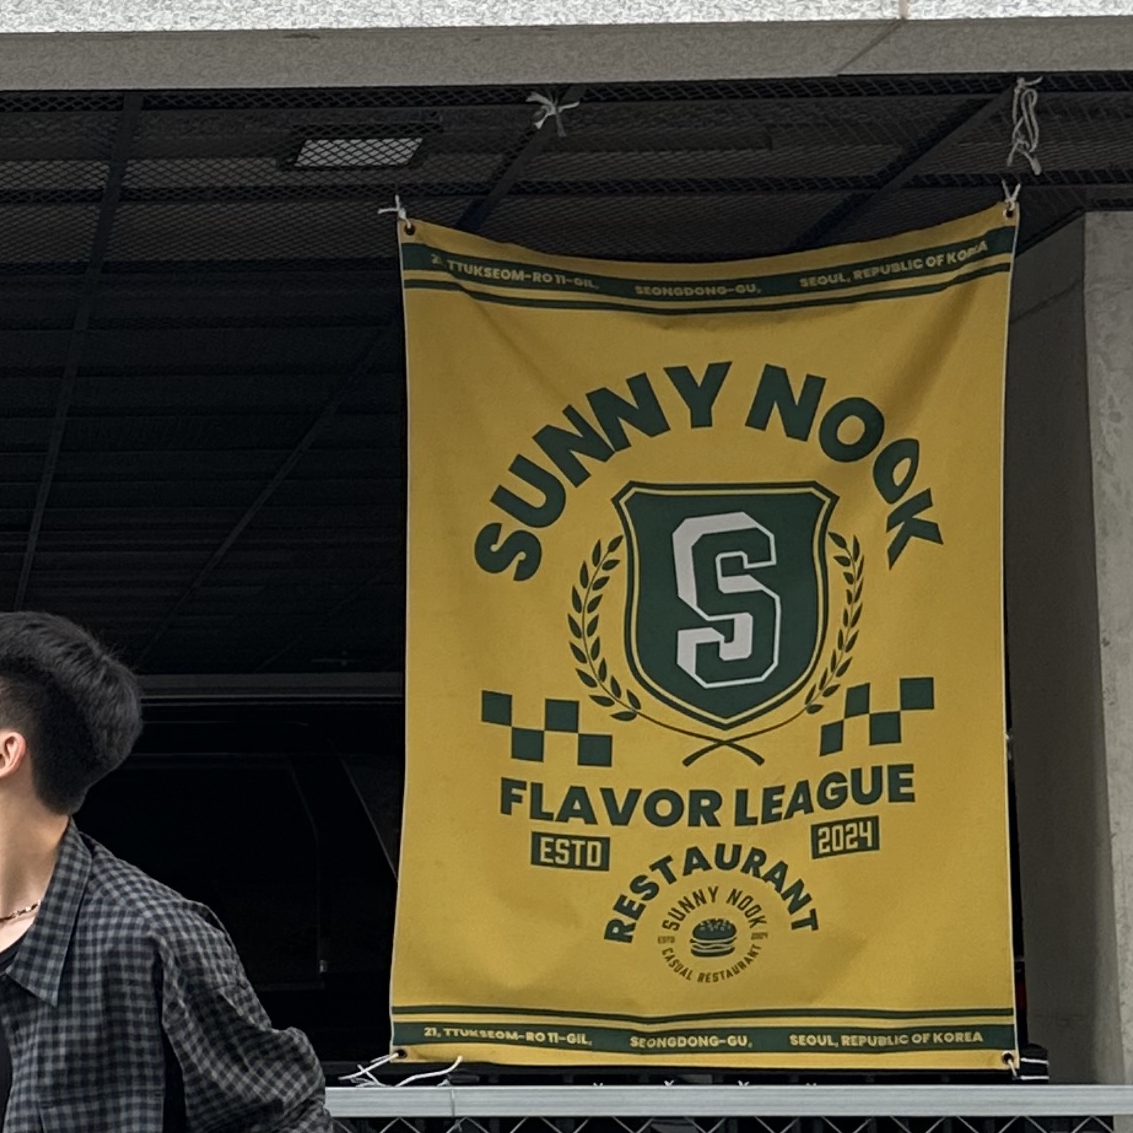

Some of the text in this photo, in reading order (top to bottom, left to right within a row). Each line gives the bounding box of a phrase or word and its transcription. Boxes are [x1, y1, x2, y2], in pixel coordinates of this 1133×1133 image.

[798, 273, 852, 289] SEOUL,
[853, 257, 924, 281] REPUBLIC
[925, 254, 945, 268] OF
[634, 282, 762, 297] SEONGDONG-GU,
[473, 361, 945, 582] SUNNY NOOK
[500, 763, 916, 828] FLAVOR LEAGUE
[539, 835, 603, 868] ESTD
[817, 820, 874, 855] 2024
[603, 842, 820, 944] RESTAURANT
[661, 885, 768, 931] SUNNY NOOK
[661, 943, 762, 983] CASUAL RESTAURANT
[423, 1027, 442, 1038] 21,
[444, 1027, 546, 1042] TTUKSEOM-RO
[629, 1034, 754, 1049] SEONGDONG-GU,
[789, 1030, 984, 1048] SEOUL, REPUBLIC OF KOREA
